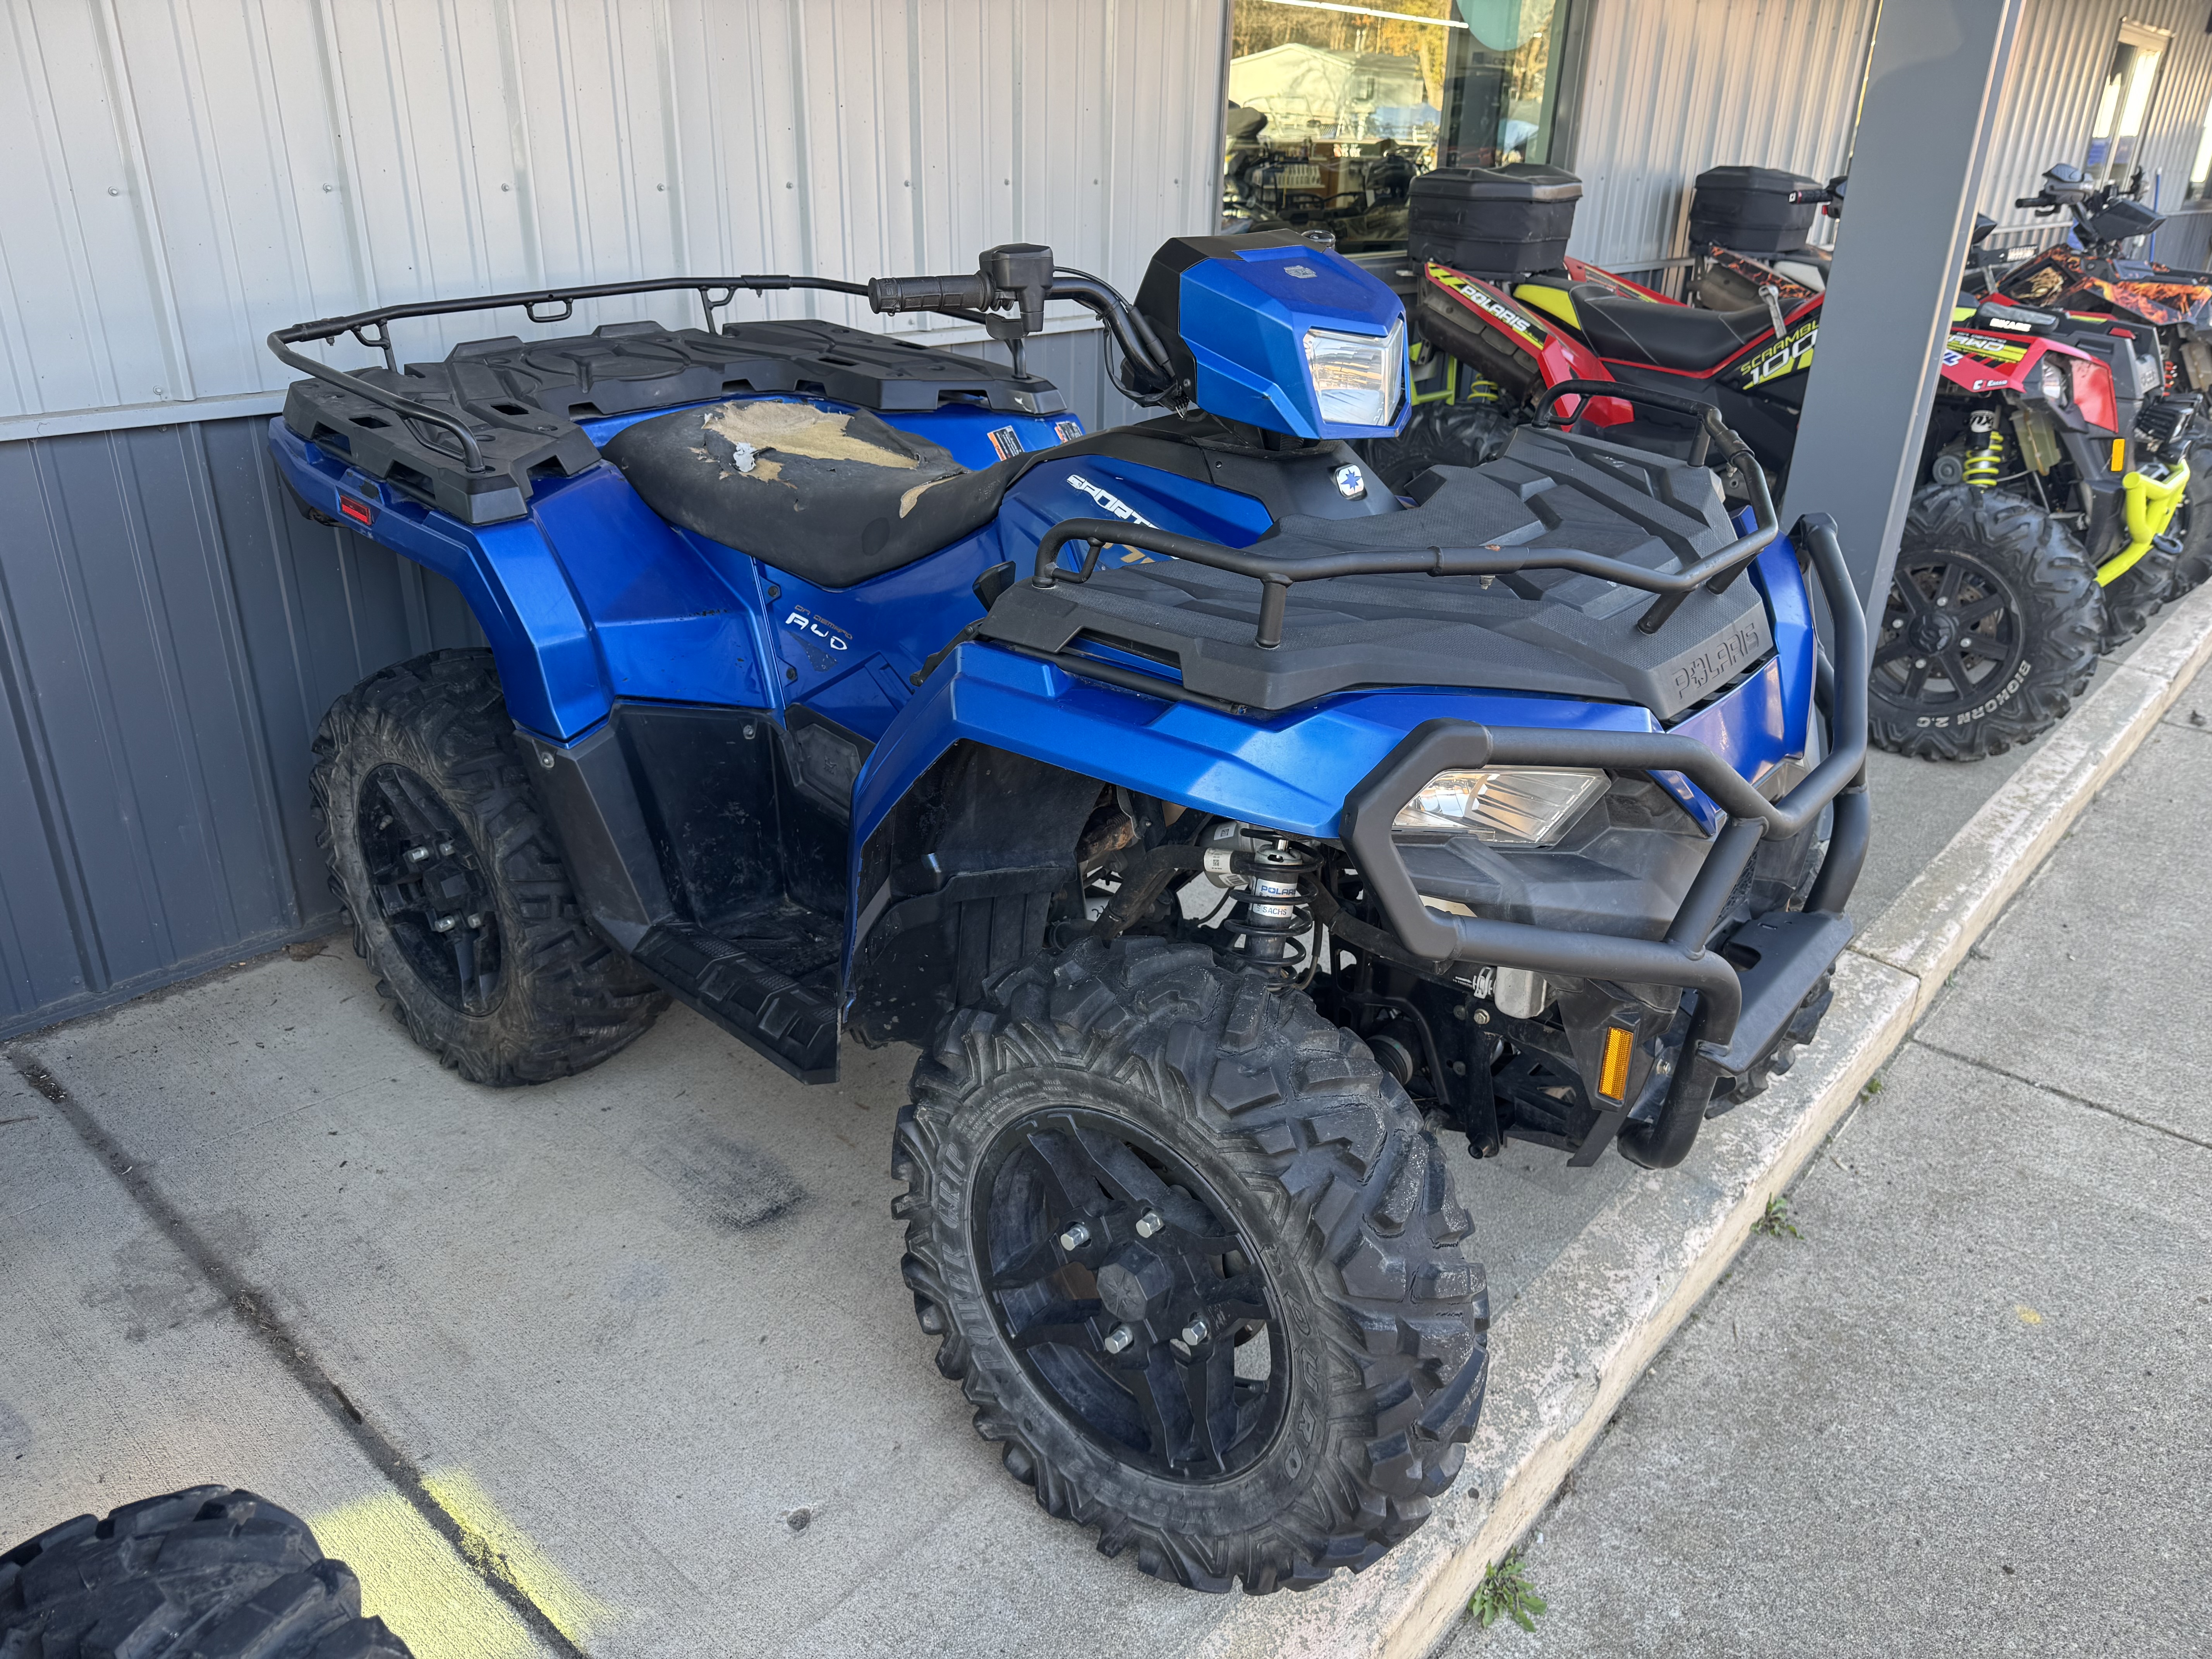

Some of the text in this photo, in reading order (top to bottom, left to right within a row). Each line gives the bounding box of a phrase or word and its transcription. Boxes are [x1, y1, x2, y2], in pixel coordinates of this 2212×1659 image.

[1460, 284, 1530, 332] POLARIS
[1948, 334, 2005, 352] AWD
[1067, 474, 1161, 530] SPORT
[785, 612, 847, 650] AWD
[1672, 623, 1759, 699] POLARIS
[1917, 659, 2031, 728] BIGHORN 2.0
[1262, 906, 1287, 915] SACHS
[938, 1142, 1008, 1370] POWER GRIP
[1283, 1291, 1319, 1479] DURO
